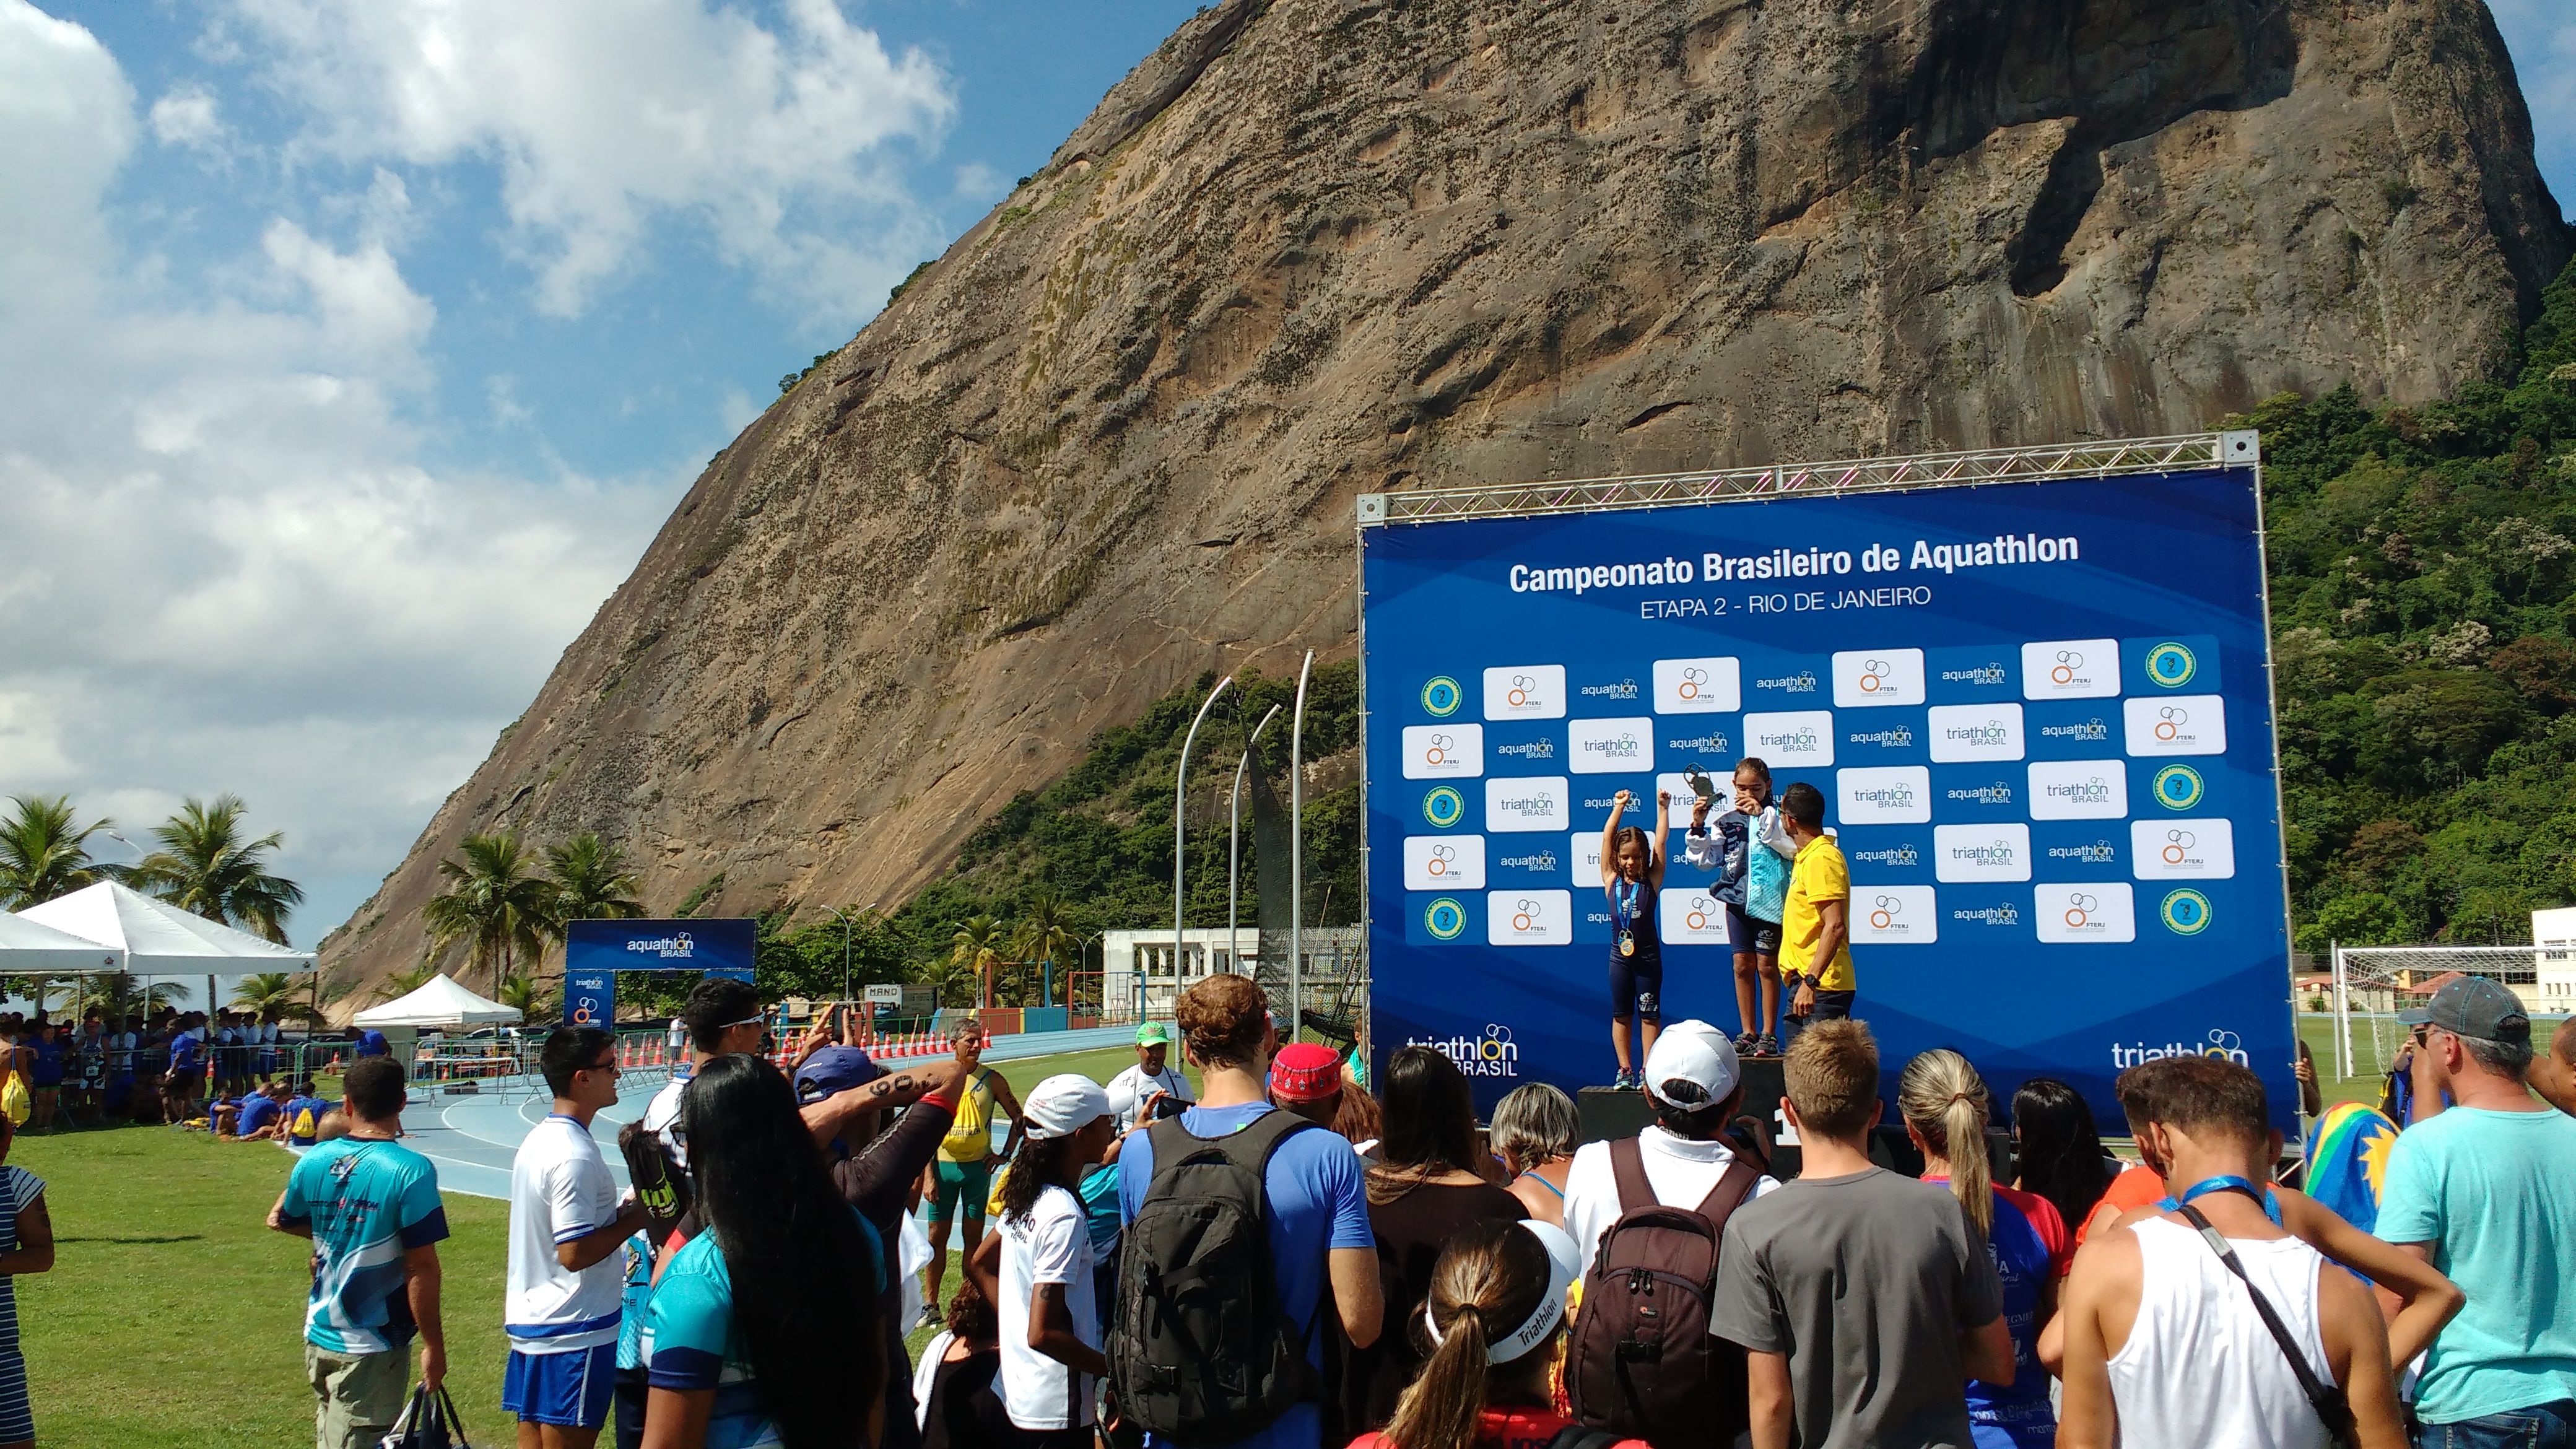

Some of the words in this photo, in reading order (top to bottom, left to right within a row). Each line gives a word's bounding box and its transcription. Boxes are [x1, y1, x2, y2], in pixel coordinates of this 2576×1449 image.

[1510, 556, 1694, 595] Campeonato
[1704, 547, 1852, 581] Brasileiro
[1861, 543, 1900, 573] de
[1910, 533, 2079, 574] Aquathlon
[1641, 599, 1708, 619] ETAPA
[1713, 598, 1726, 615] 2
[1749, 594, 1788, 614] RIO
[1795, 593, 1825, 611] DE
[1831, 586, 1931, 609] JANEIRO
[1943, 668, 2005, 682] aquathlon
[1581, 682, 1637, 697] aquathlon
[1757, 676, 1816, 690] aquathlon
[1850, 730, 1912, 744] aquathlon
[1946, 726, 2006, 740] triathlon
[2042, 723, 2107, 738] aquathlon
[1584, 739, 1638, 751] triathlon
[1669, 737, 1727, 750] aquathlon
[1760, 734, 1816, 746] triathlon
[1881, 739, 1912, 747] BRASIL
[1970, 738, 2006, 746] BRASIL
[1499, 742, 1553, 755] aquathlon
[1606, 749, 1638, 758] BRASIL
[1783, 744, 1817, 752] BRASIL
[1854, 789, 1913, 802] triathlon
[1947, 786, 2011, 801] aquathlon
[2047, 783, 2108, 796] triathlon
[1501, 798, 1553, 811] triathlon
[1878, 799, 1913, 808] BRASIL
[1980, 796, 2011, 804] BRASIL
[2072, 794, 2108, 803] BRASIL
[1856, 850, 1917, 862] aquathlon
[1952, 846, 2012, 859] triathlon
[2048, 845, 2114, 859] aquathlon
[1500, 855, 1556, 868] aquathlon
[1977, 857, 2012, 866] BRASIL
[1954, 909, 2017, 923] aquathlon
[627, 938, 694, 953] aquathlon
[660, 949, 693, 957] BRASIL
[1517, 1297, 1557, 1346] Triathlon
